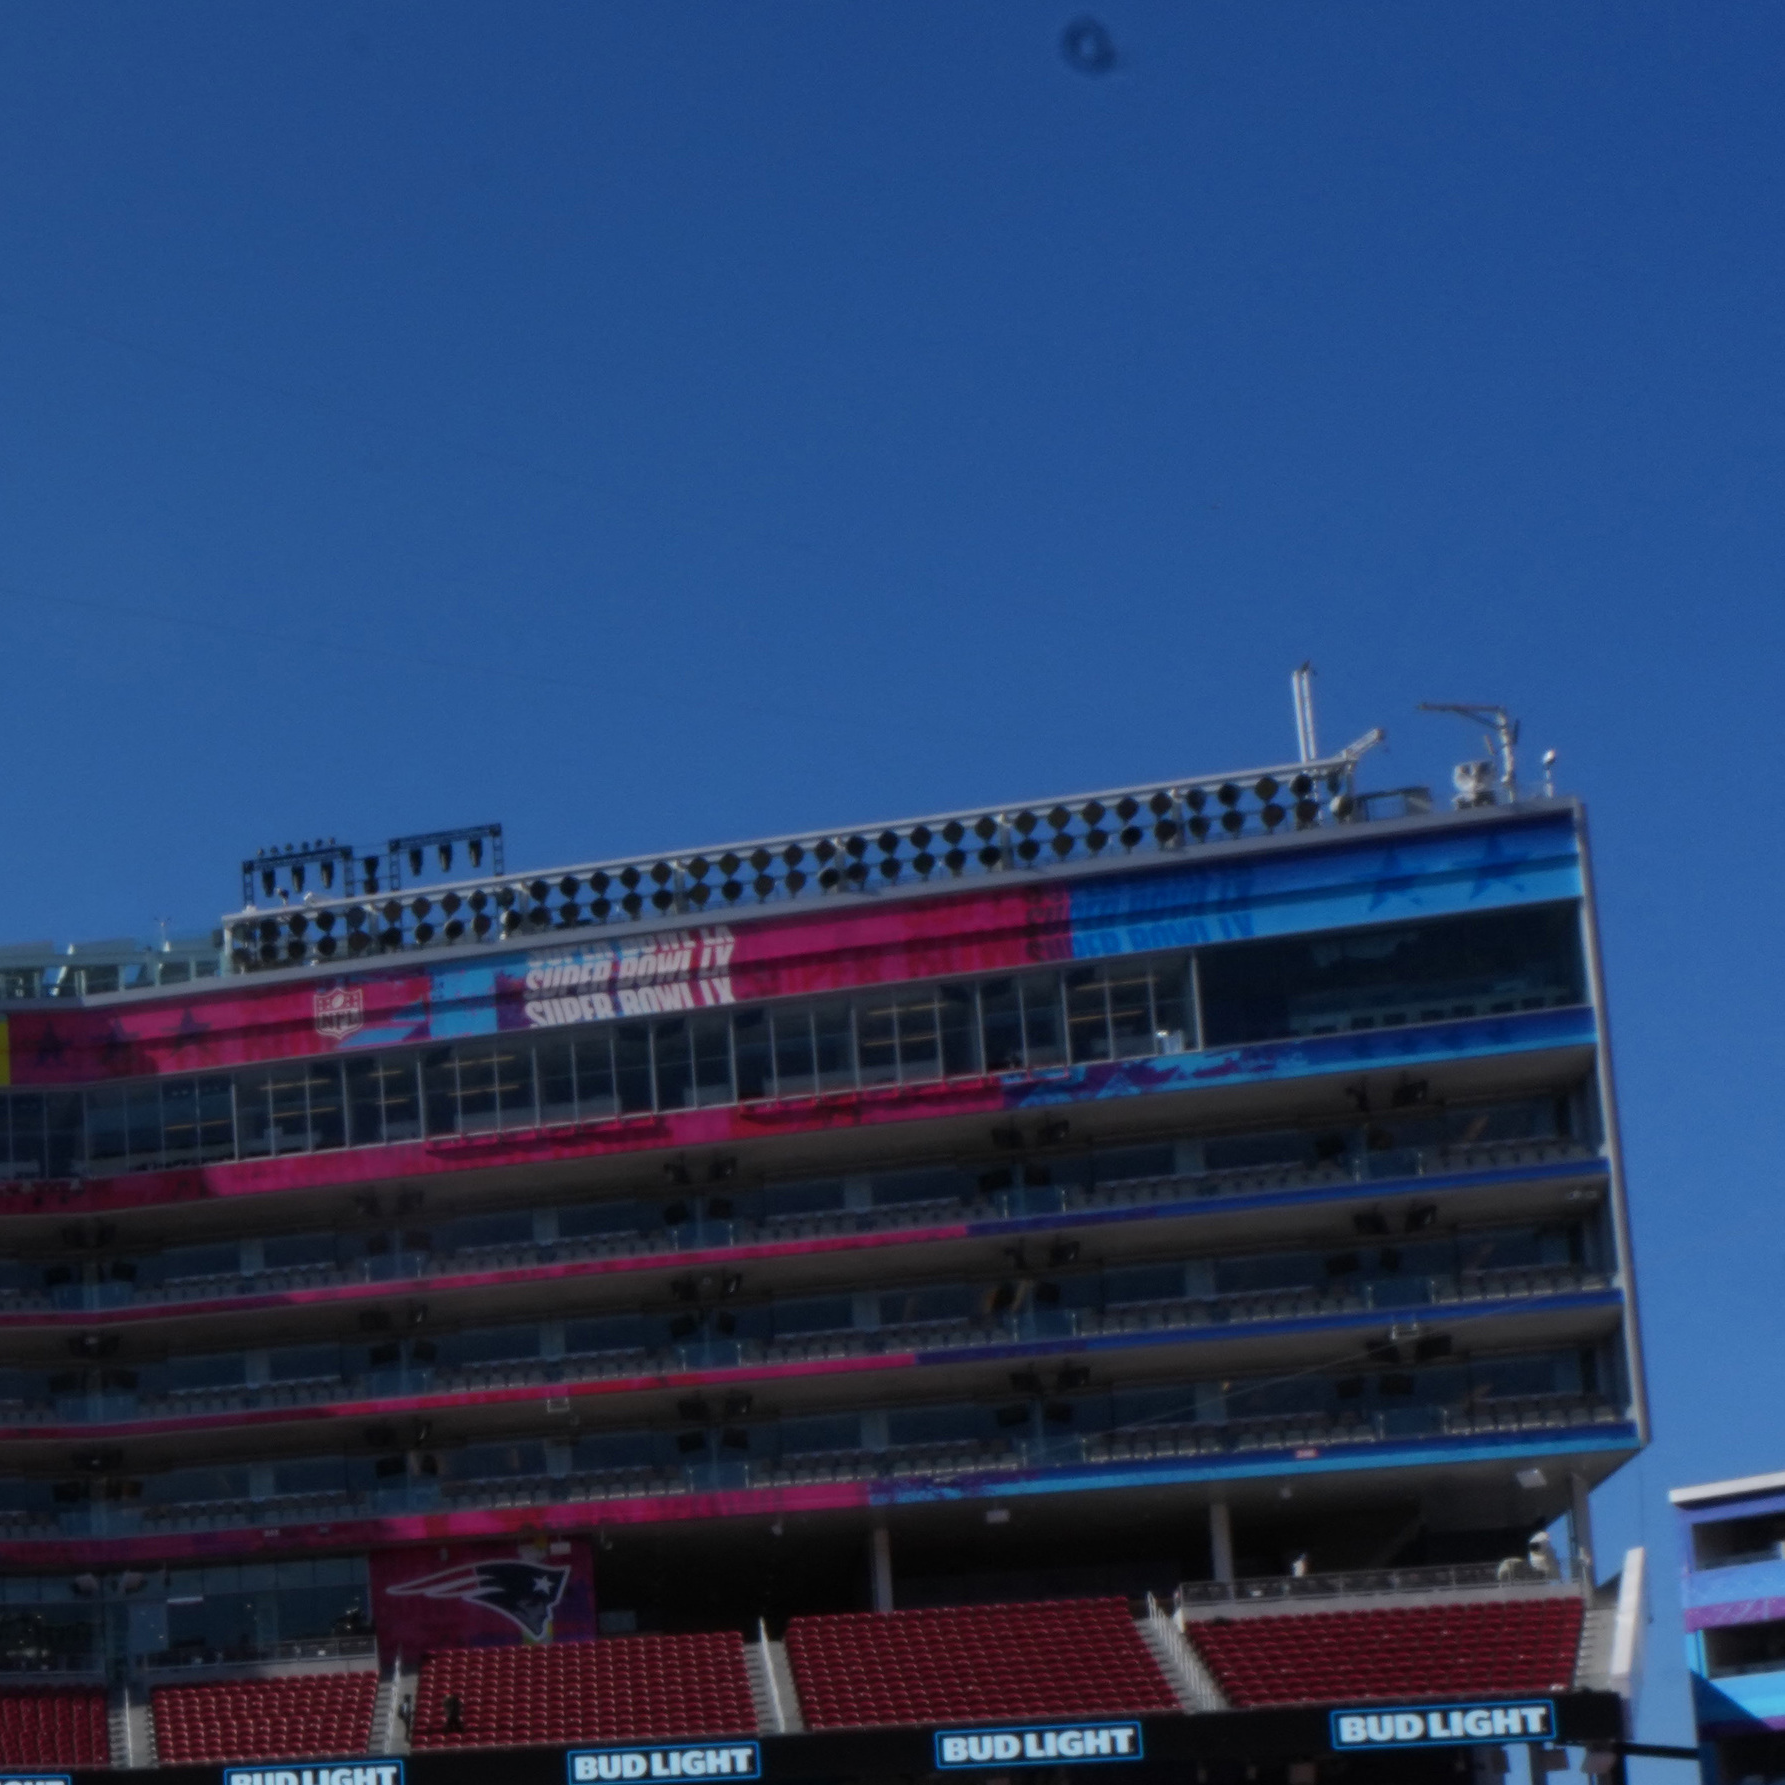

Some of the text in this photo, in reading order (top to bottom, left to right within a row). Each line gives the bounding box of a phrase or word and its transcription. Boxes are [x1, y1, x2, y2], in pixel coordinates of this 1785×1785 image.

[1340, 1706, 1548, 1743] BUD LIGHT
[943, 1727, 1136, 1762] BUD LIGHT
[574, 1747, 754, 1781] BUD LIGHT
